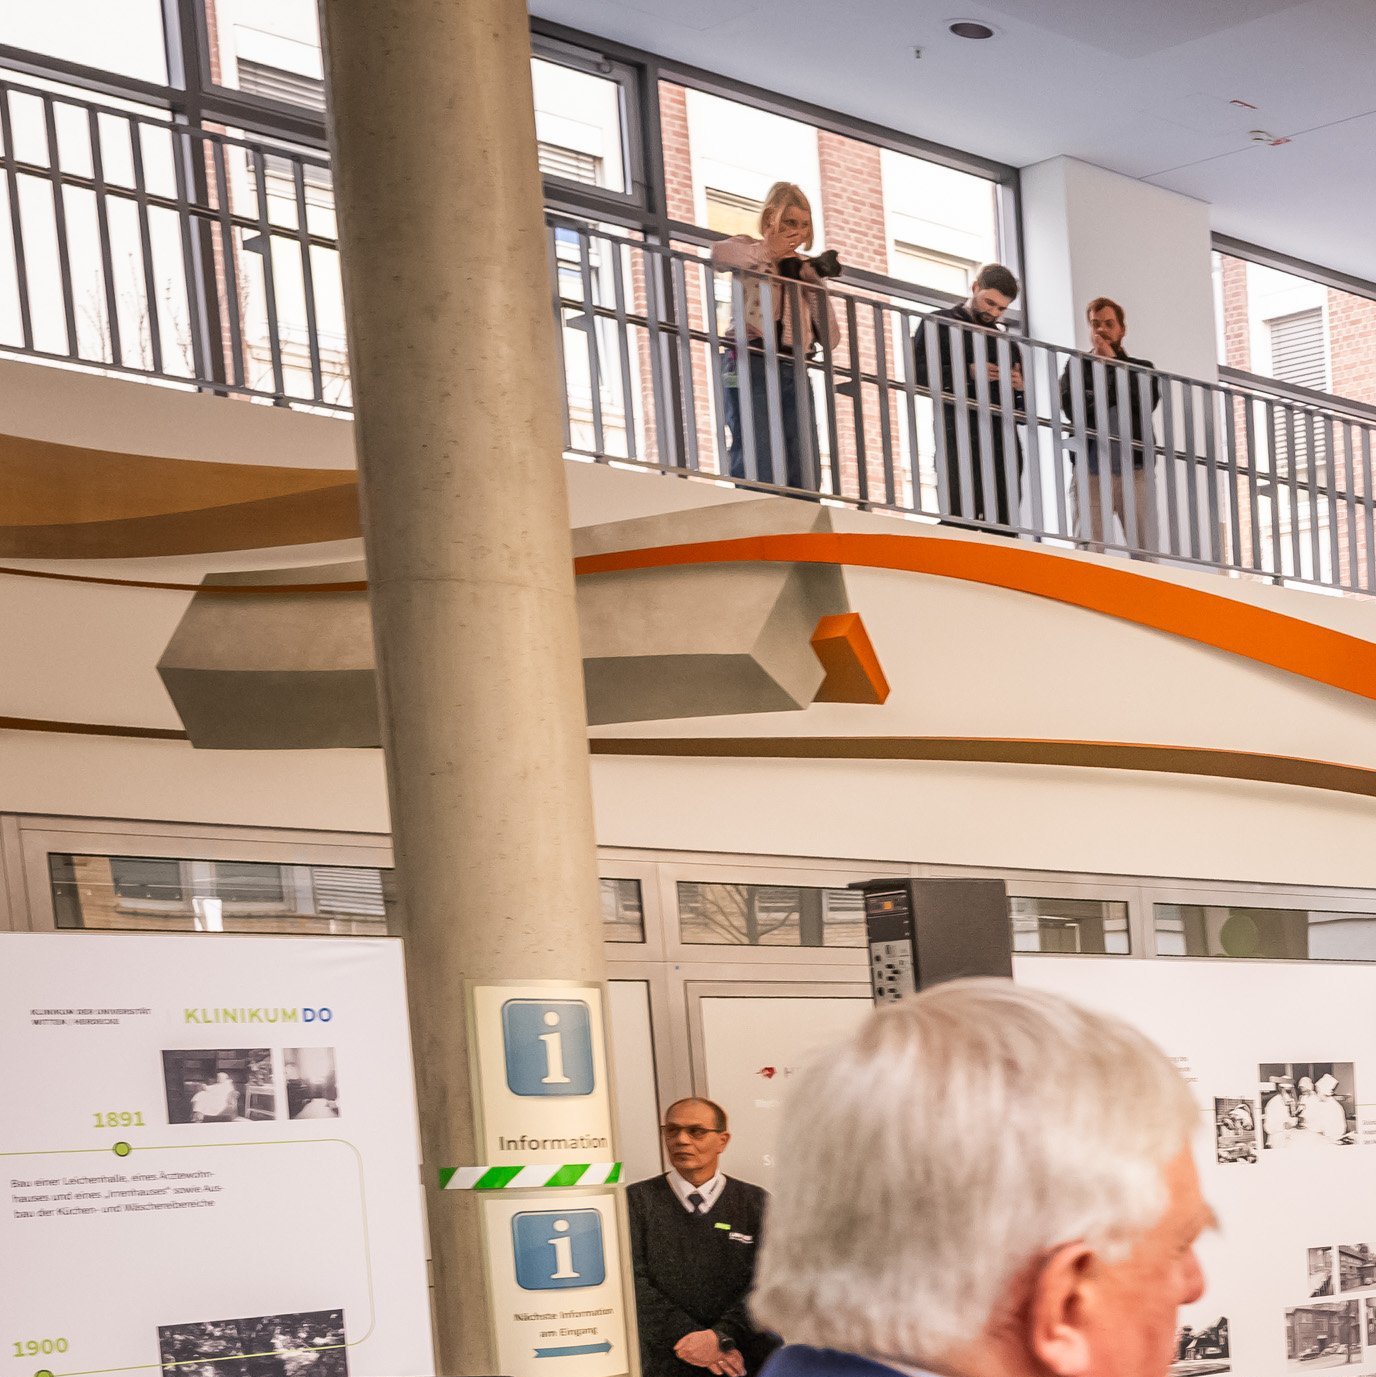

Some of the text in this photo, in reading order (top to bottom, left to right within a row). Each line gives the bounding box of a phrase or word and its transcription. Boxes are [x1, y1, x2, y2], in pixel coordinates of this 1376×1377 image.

[93, 1111, 145, 1128] 1891
[499, 1134, 608, 1151] Information
[12, 1337, 69, 1358] 1900
